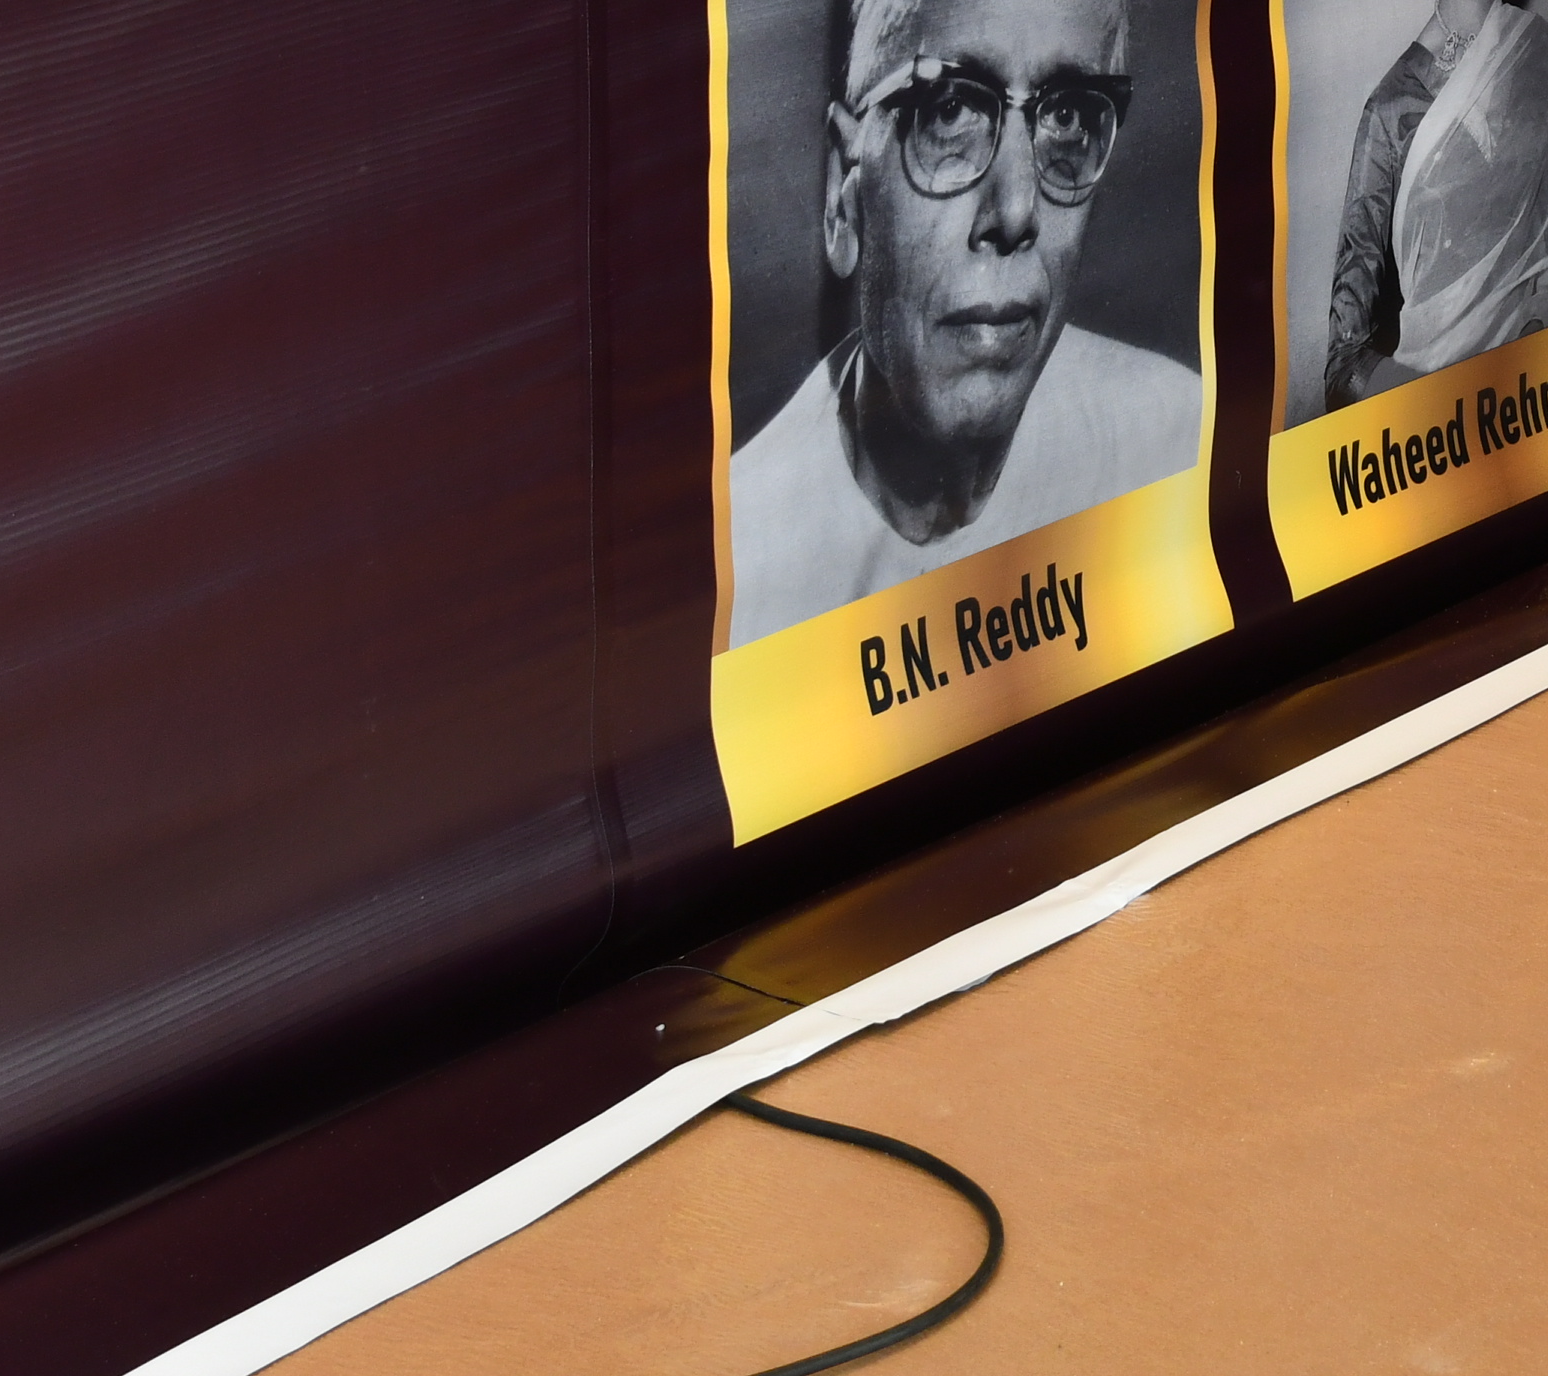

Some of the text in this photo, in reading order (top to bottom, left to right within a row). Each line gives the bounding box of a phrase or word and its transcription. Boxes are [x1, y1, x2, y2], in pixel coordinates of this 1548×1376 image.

[1327, 398, 1468, 516] Waheed
[860, 563, 1087, 716] B.N. Reddy
